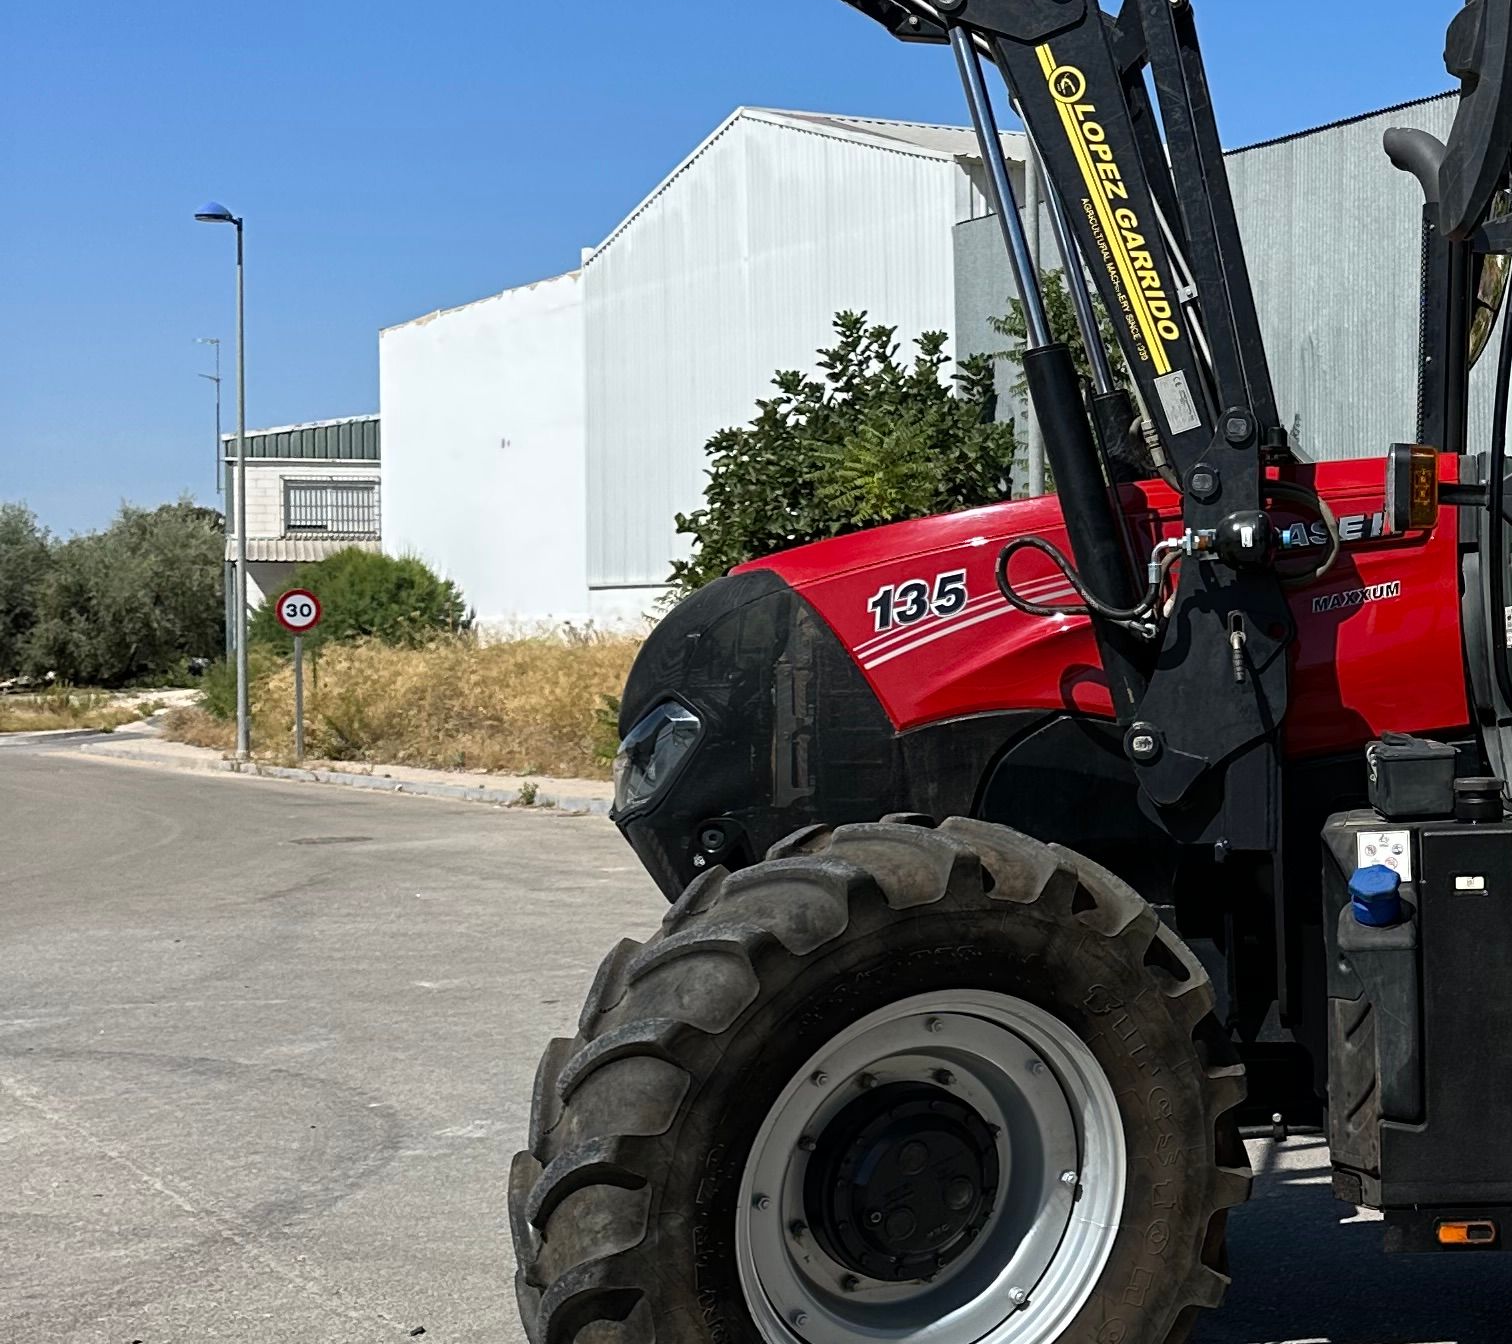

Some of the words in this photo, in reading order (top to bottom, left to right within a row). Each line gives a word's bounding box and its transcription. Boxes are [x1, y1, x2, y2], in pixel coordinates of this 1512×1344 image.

[1073, 103, 1128, 200] LOPEZ
[1115, 208, 1179, 341] GARRIDO
[1125, 312, 1141, 341] SINCE
[285, 603, 312, 618] 30
[866, 568, 968, 632] 135
[1311, 580, 1401, 613] MAXXUM
